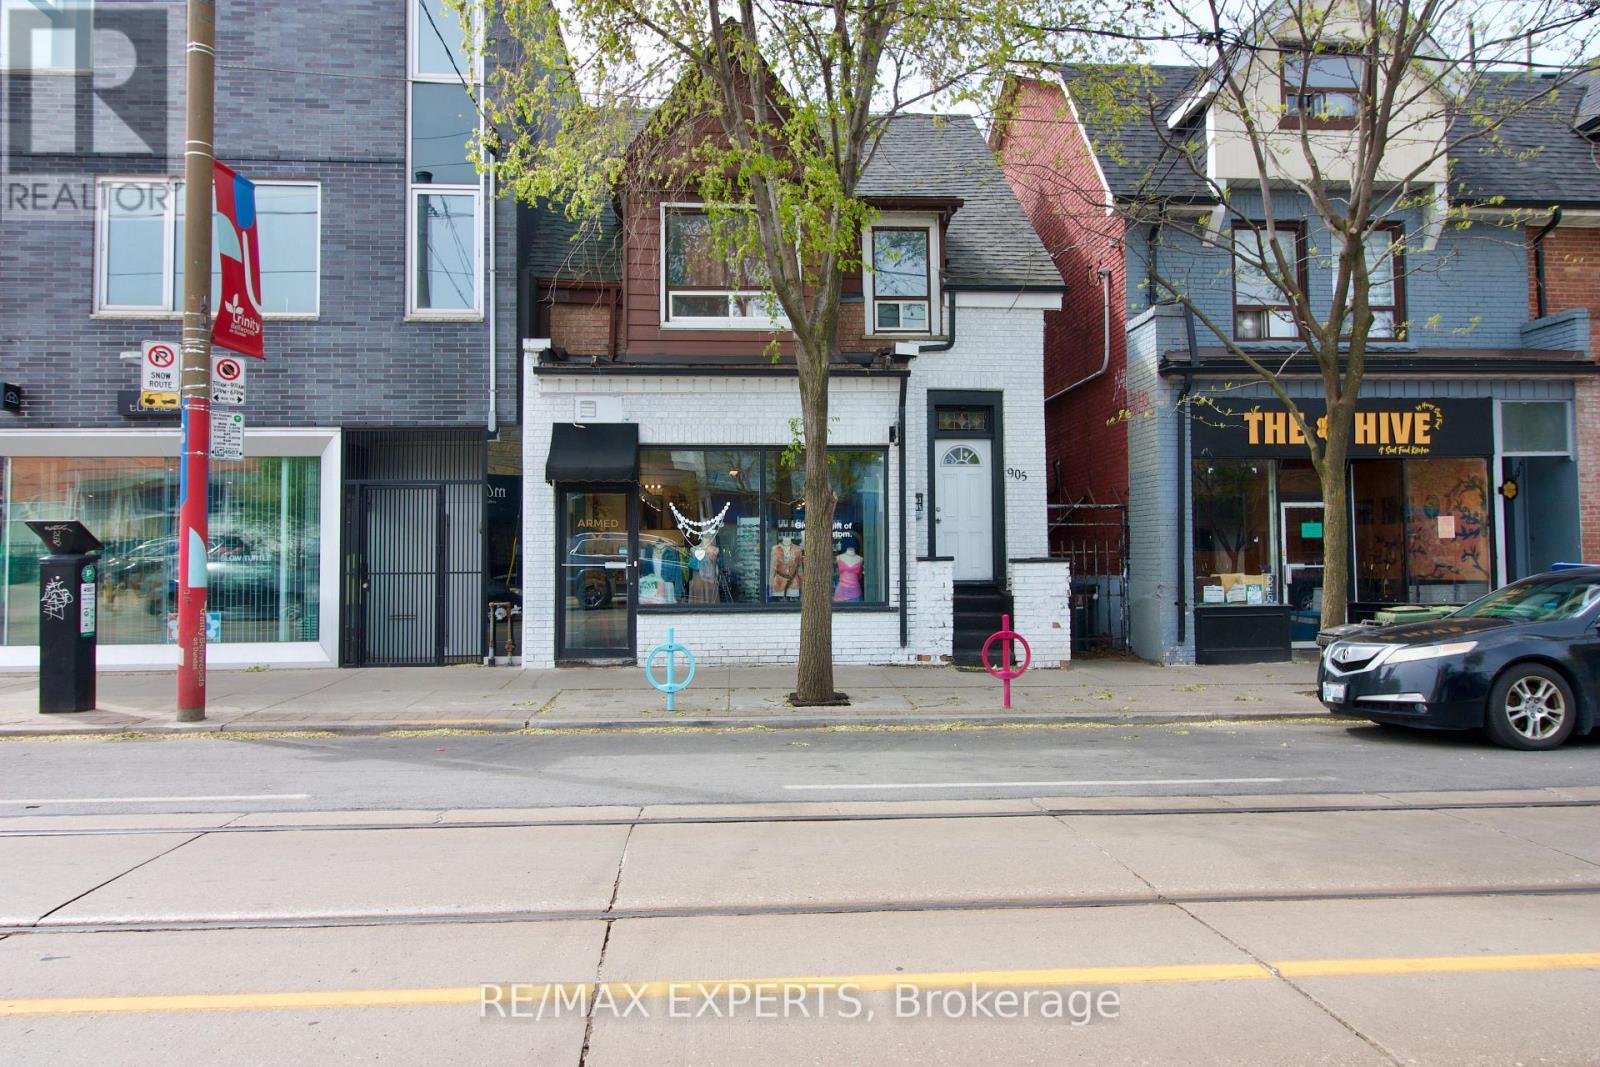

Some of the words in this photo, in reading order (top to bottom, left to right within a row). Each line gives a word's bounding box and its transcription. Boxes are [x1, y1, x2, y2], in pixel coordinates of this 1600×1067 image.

[149, 381, 173, 389] ROUTE
[1355, 412, 1431, 445] HIVE
[1007, 468, 1028, 481] 905
[577, 519, 619, 528] ARMED
